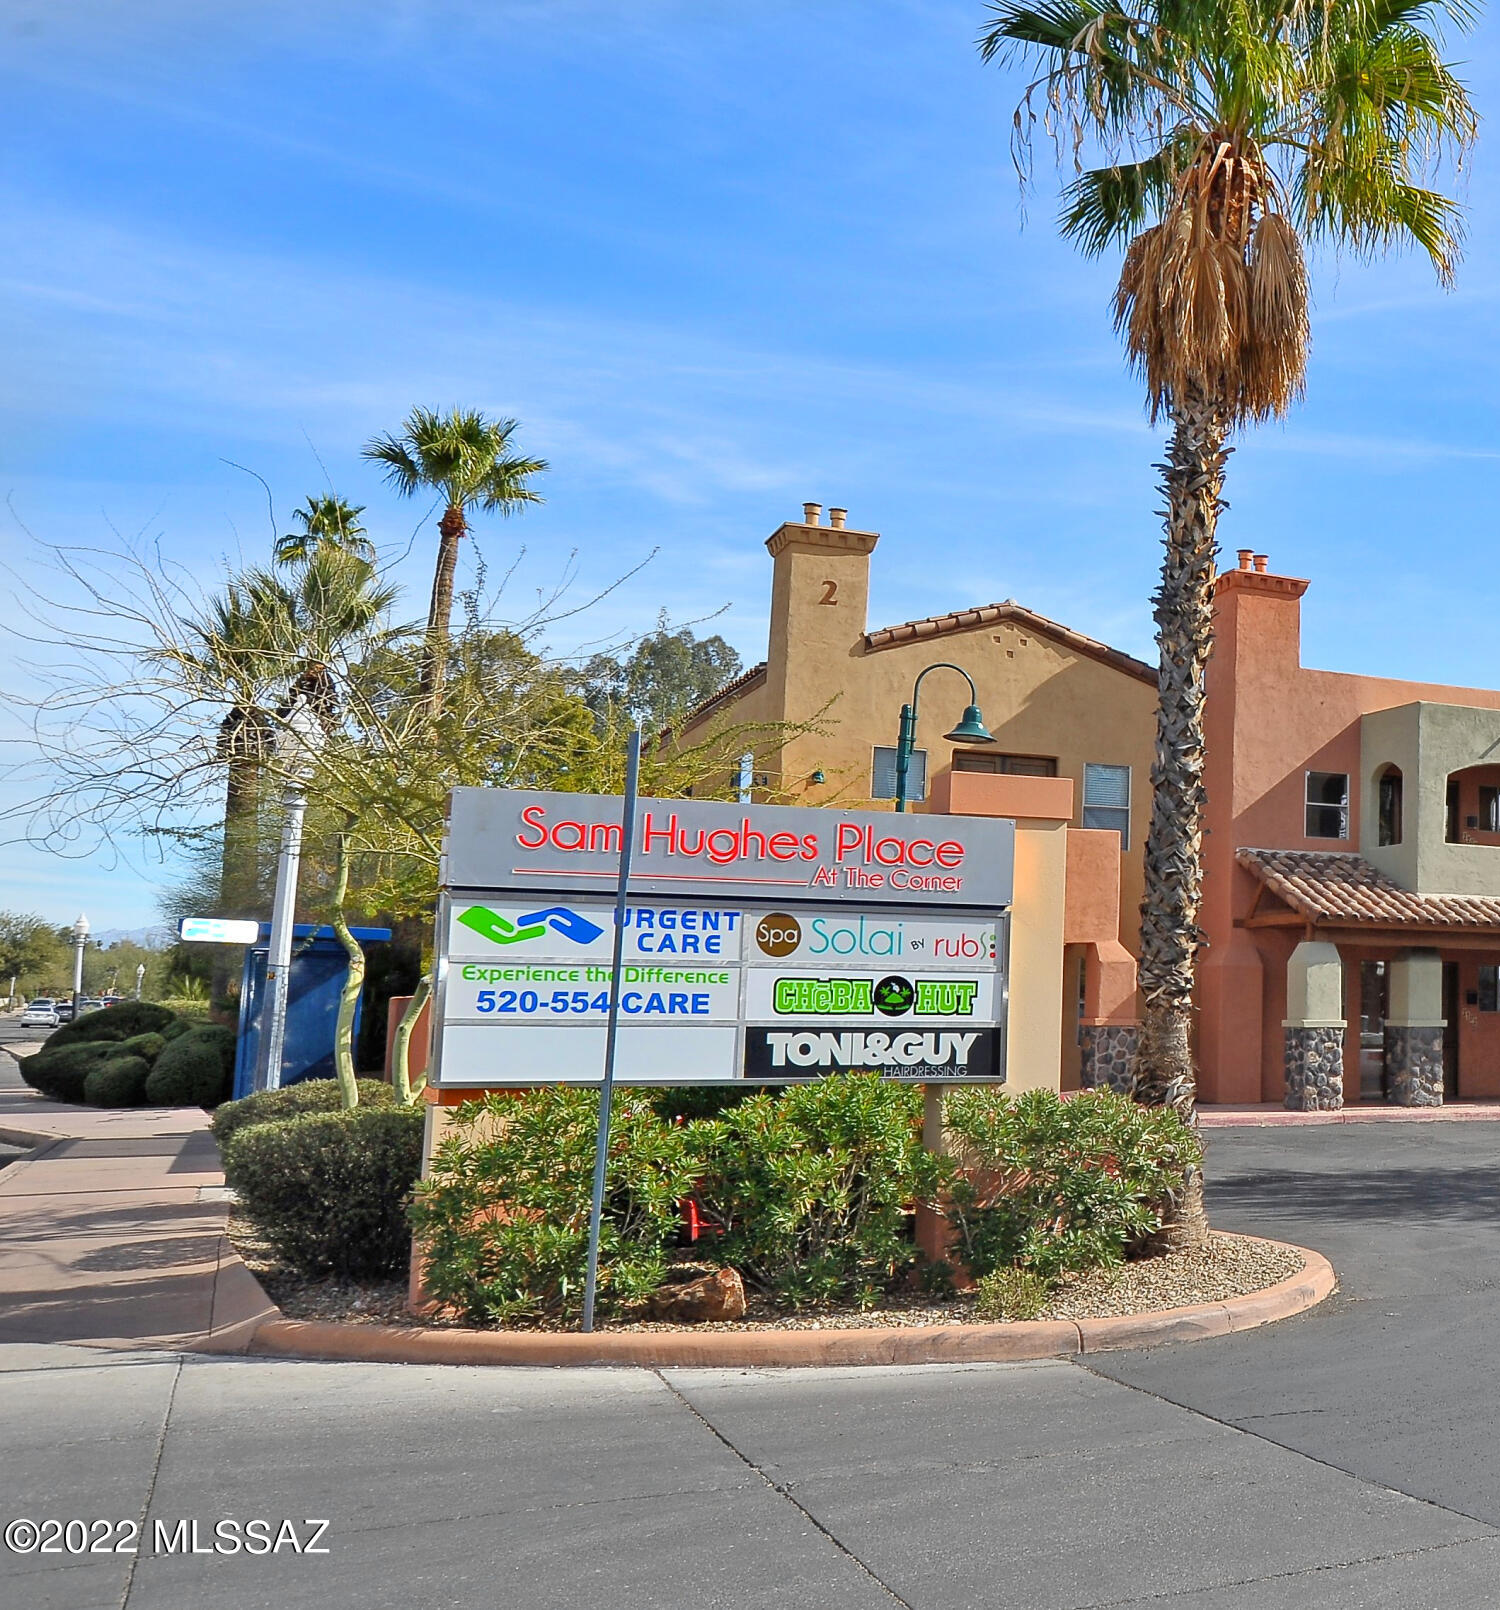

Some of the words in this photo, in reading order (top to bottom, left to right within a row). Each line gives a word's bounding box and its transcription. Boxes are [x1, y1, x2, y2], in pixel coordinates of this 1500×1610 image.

[818, 580, 838, 606] 2
[516, 805, 624, 851] Sam
[642, 813, 820, 865] Hughes
[835, 822, 966, 869] Place
[812, 864, 838, 887] At
[844, 866, 884, 889] The
[890, 868, 963, 892] Corner
[614, 907, 741, 931] URGENT
[637, 932, 721, 954] CARE
[757, 923, 799, 947] Spa
[809, 915, 903, 956] Solai
[910, 938, 926, 951] BY
[462, 964, 579, 984] Experience
[625, 966, 729, 984] Difference
[916, 981, 977, 1014] HUT
[766, 1032, 979, 1067] TONI&GUY
[883, 1065, 968, 1077] HAIRDRESSING
